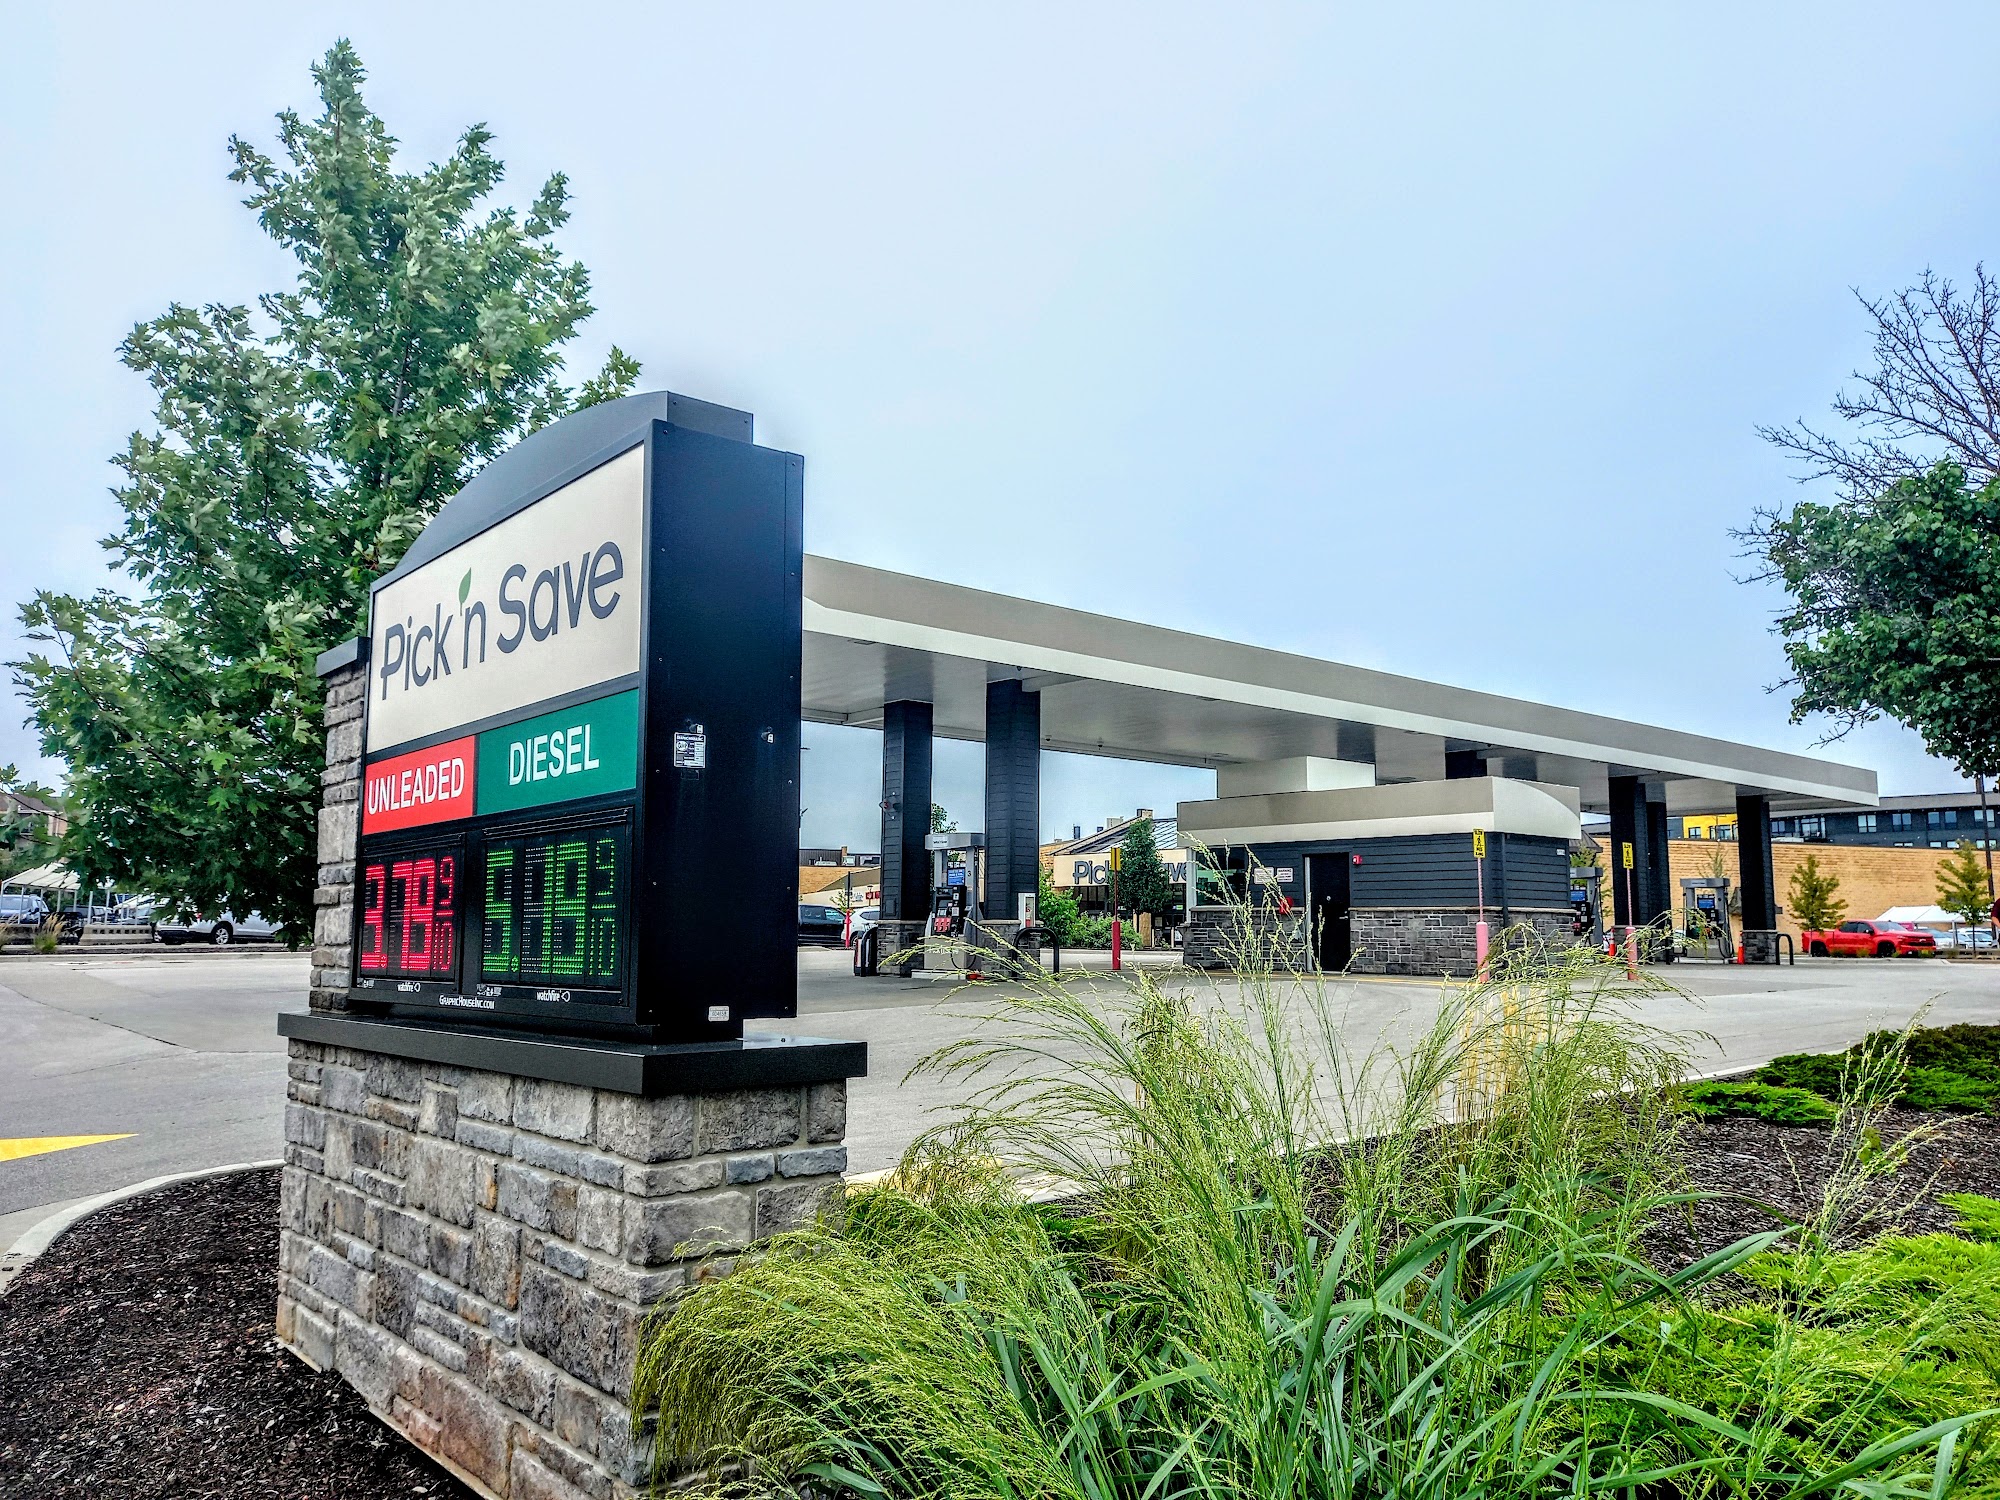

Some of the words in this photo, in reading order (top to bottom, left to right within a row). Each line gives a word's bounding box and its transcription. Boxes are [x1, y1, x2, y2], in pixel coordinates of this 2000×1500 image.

[380, 602, 453, 700] Pick
[496, 541, 624, 654] Save
[508, 723, 600, 786] DIESEL
[367, 757, 465, 815] UNLEADED
[536, 989, 561, 1002] watchfire
